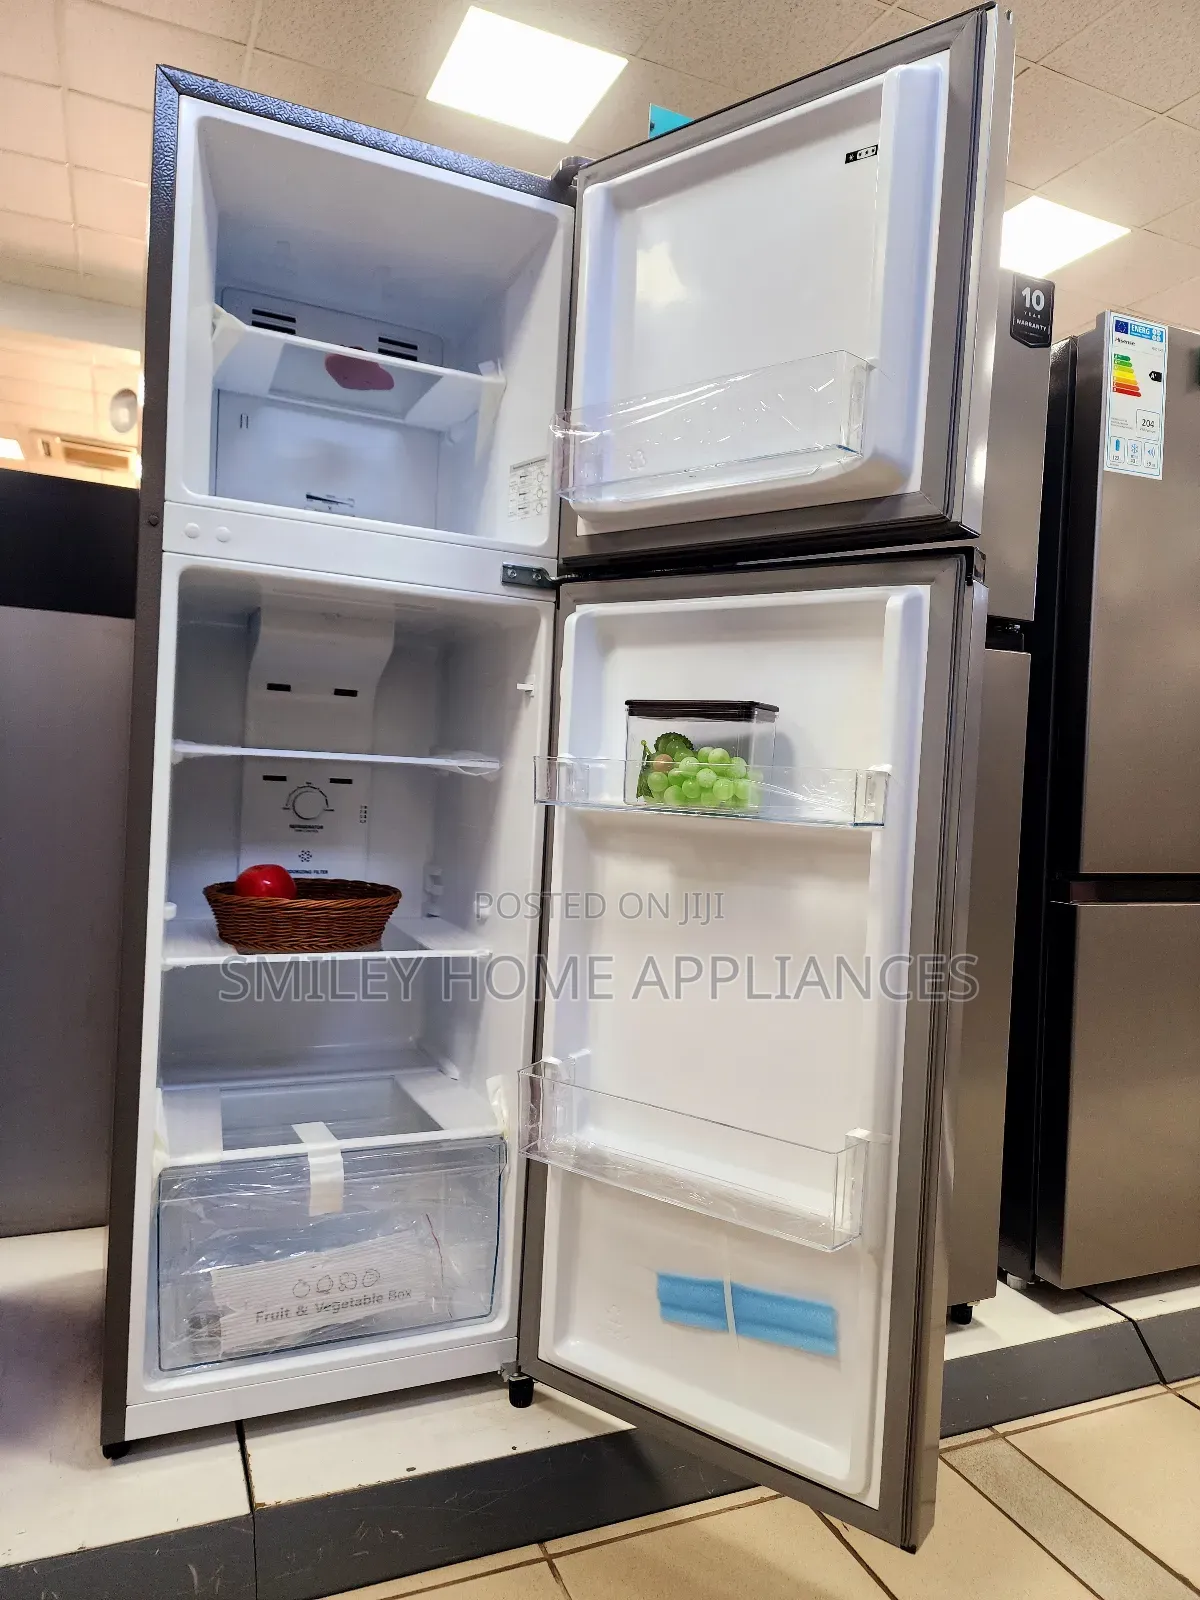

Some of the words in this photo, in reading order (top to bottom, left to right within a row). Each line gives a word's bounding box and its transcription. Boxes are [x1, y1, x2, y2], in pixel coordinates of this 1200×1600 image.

[1021, 286, 1045, 311] 10
[1023, 310, 1041, 319] YEAR
[1016, 318, 1047, 332] WARRANTY
[1131, 325, 1151, 335] ENERG
[1141, 418, 1155, 428] 204
[255, 1308, 291, 1323] Fruit
[315, 1293, 384, 1315] Vegetable
[388, 1289, 412, 1301] Box
